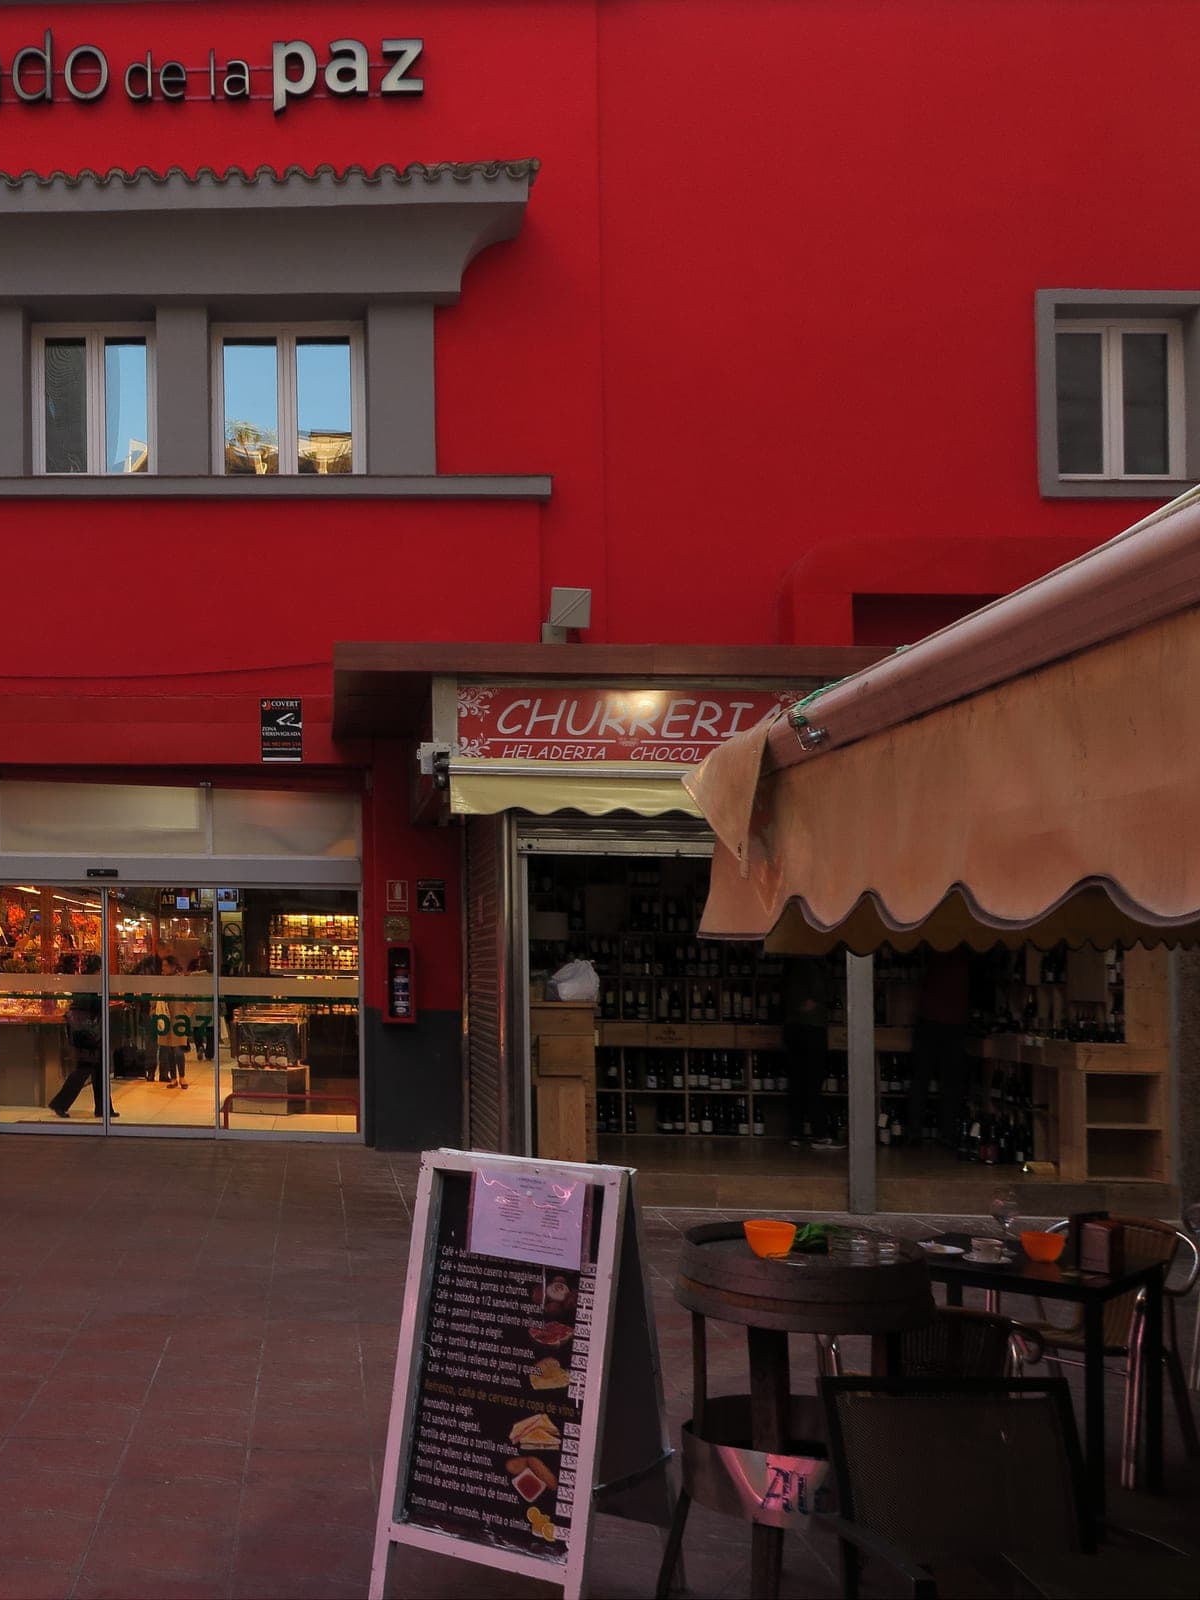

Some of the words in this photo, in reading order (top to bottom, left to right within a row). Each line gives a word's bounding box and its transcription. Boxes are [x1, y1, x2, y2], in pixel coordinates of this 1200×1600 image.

[124, 51, 186, 102] de
[209, 48, 250, 101] la
[272, 39, 425, 115] paz
[502, 745, 606, 760] HELADERIA
[151, 1013, 212, 1041] paz
